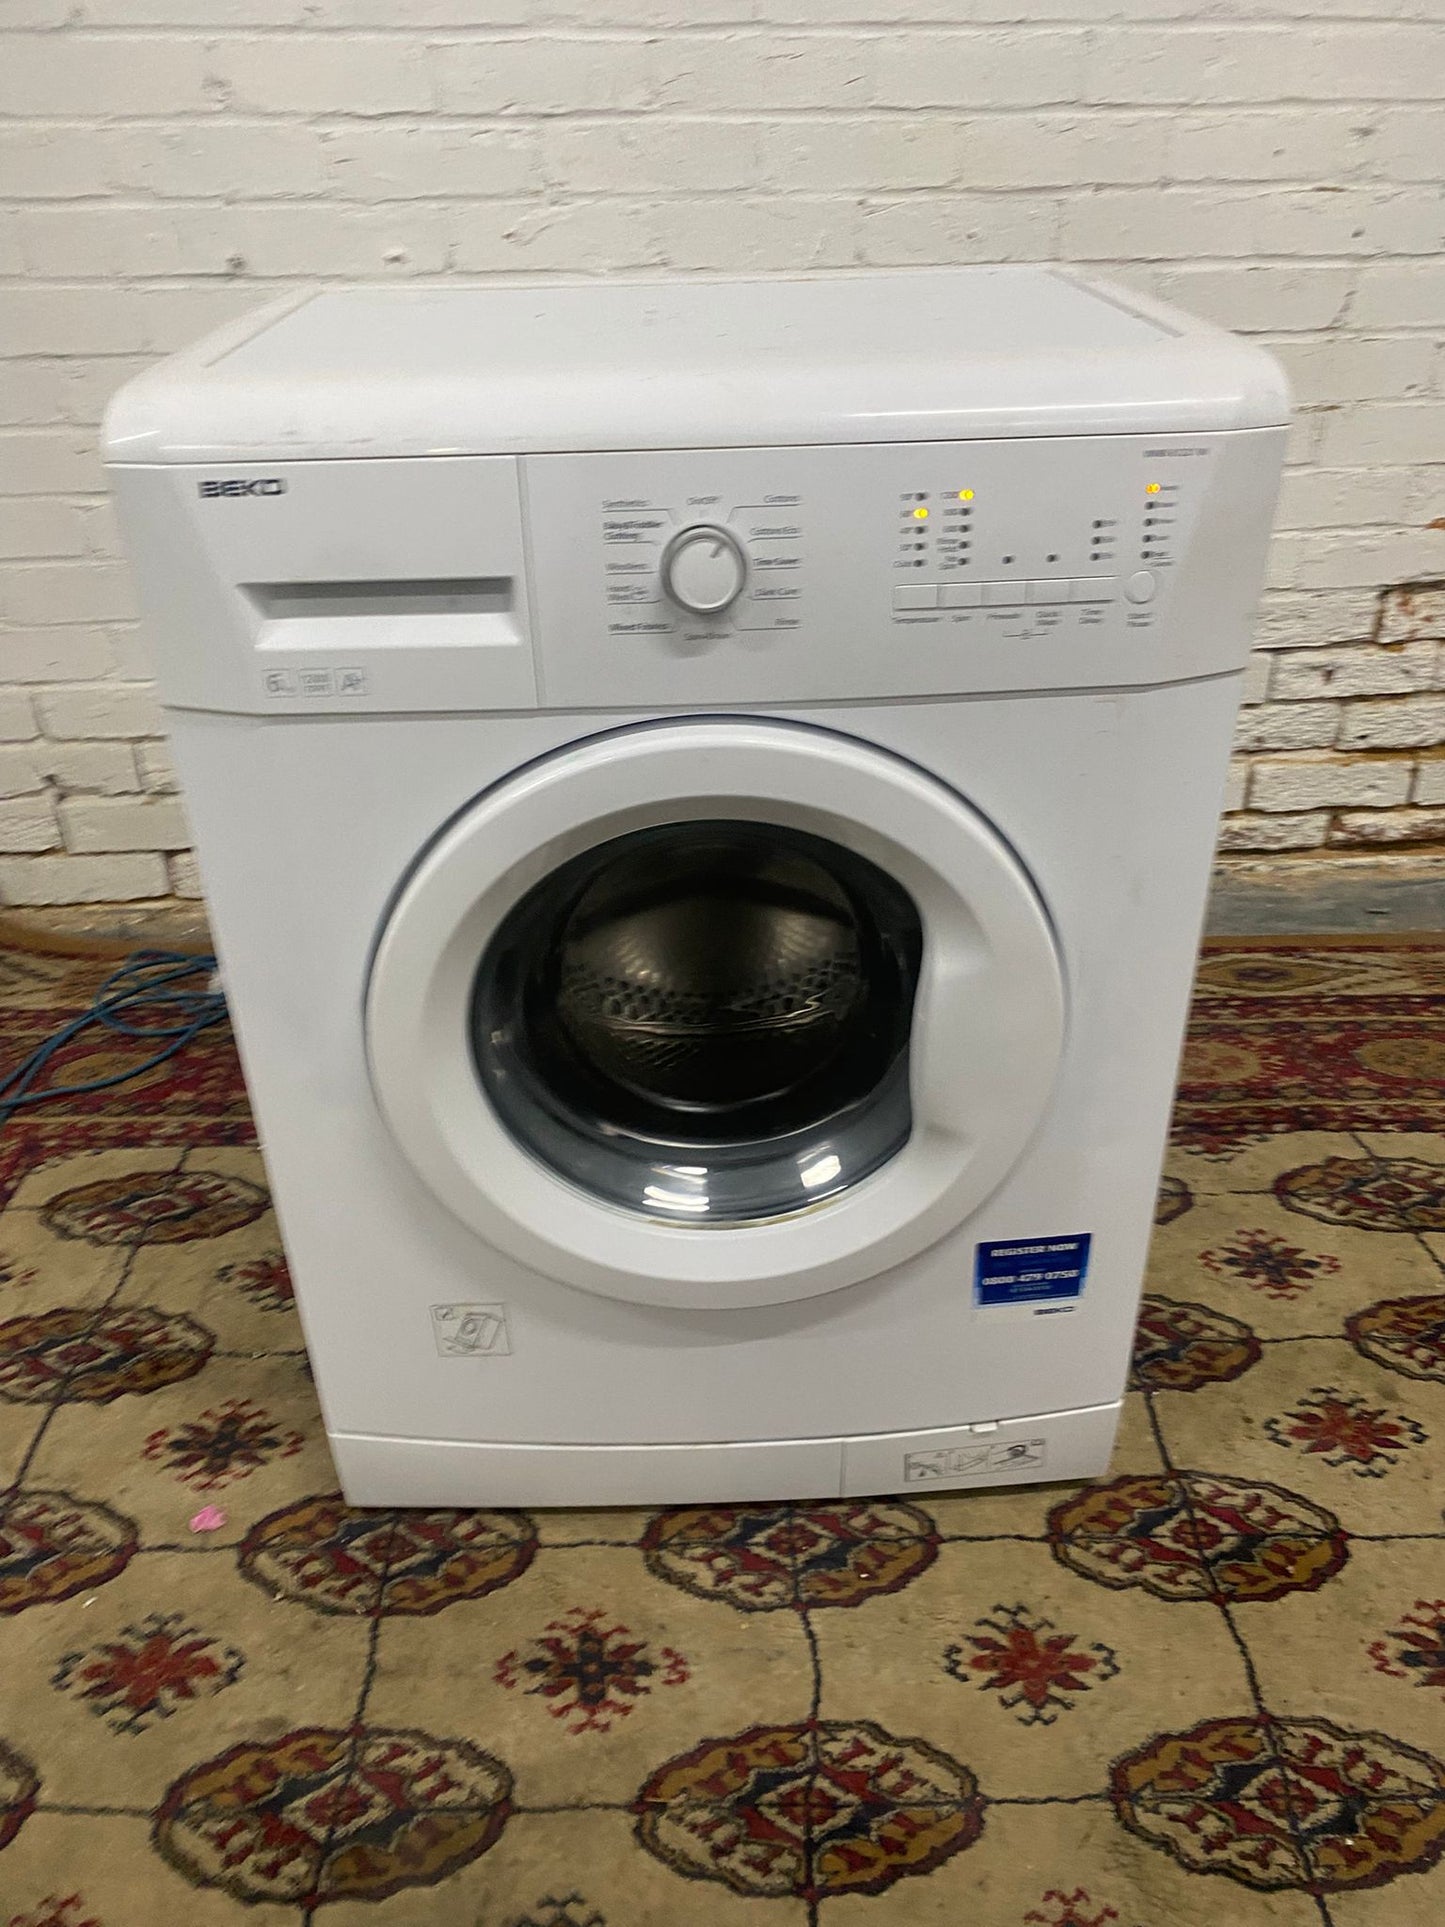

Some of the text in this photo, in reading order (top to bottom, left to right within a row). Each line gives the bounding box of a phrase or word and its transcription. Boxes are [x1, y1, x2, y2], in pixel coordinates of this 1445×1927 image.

[198, 478, 287, 498] BEKO
[991, 1243, 1079, 1257] REGISTER NOW
